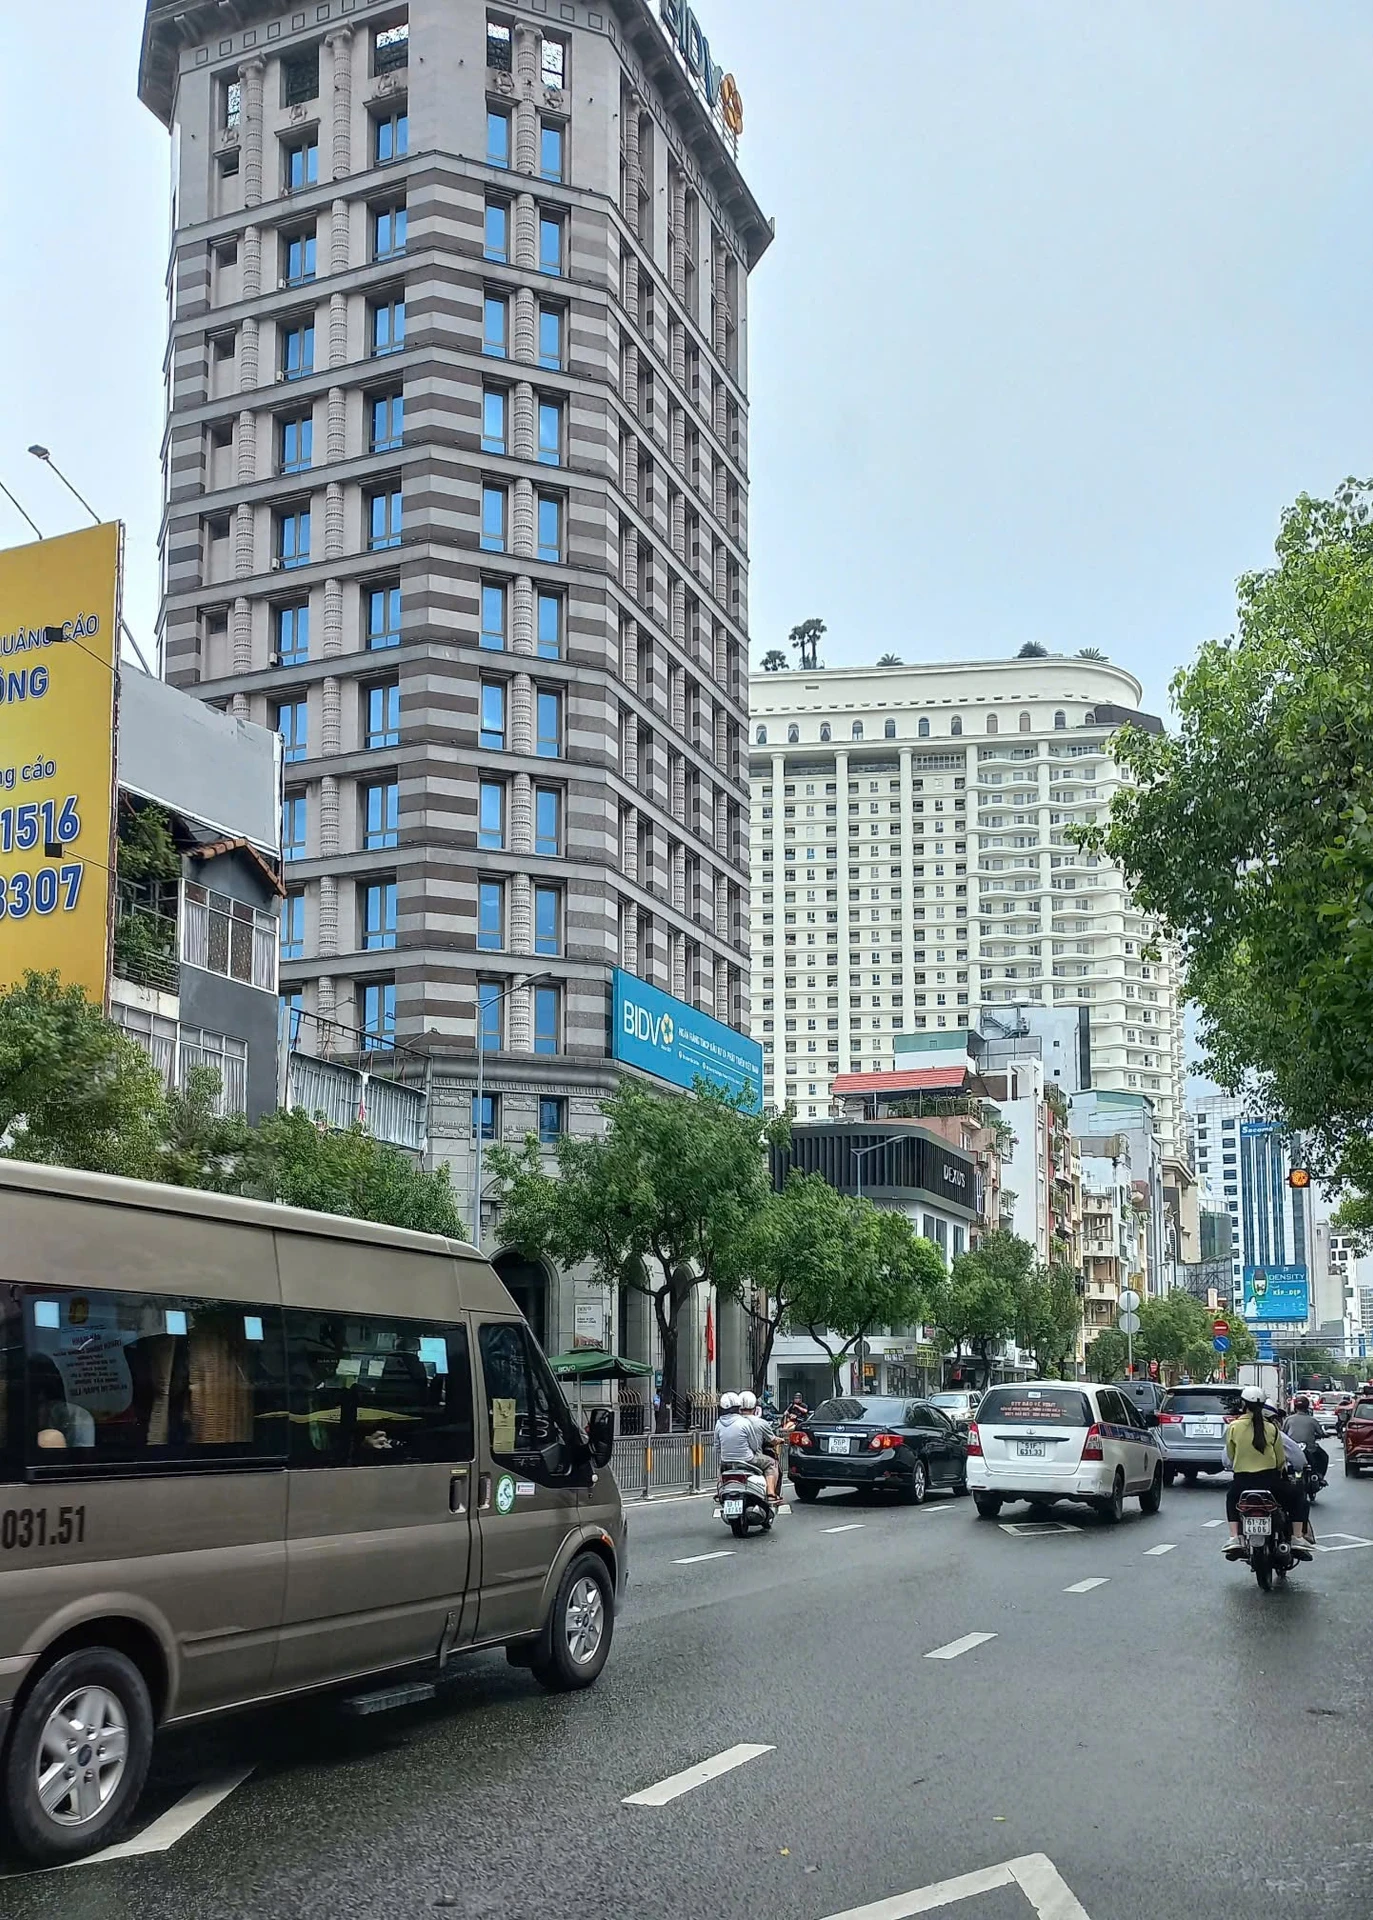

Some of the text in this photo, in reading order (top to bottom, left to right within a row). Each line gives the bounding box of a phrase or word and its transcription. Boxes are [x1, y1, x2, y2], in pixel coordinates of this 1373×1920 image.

[0, 625, 54, 655] UẢN
[22, 754, 56, 781] cáo
[0, 795, 81, 852] 1516
[624, 999, 661, 1046] BIDV
[1268, 1273, 1306, 1281] DENSITY
[2, 1505, 86, 1550] 031.51
